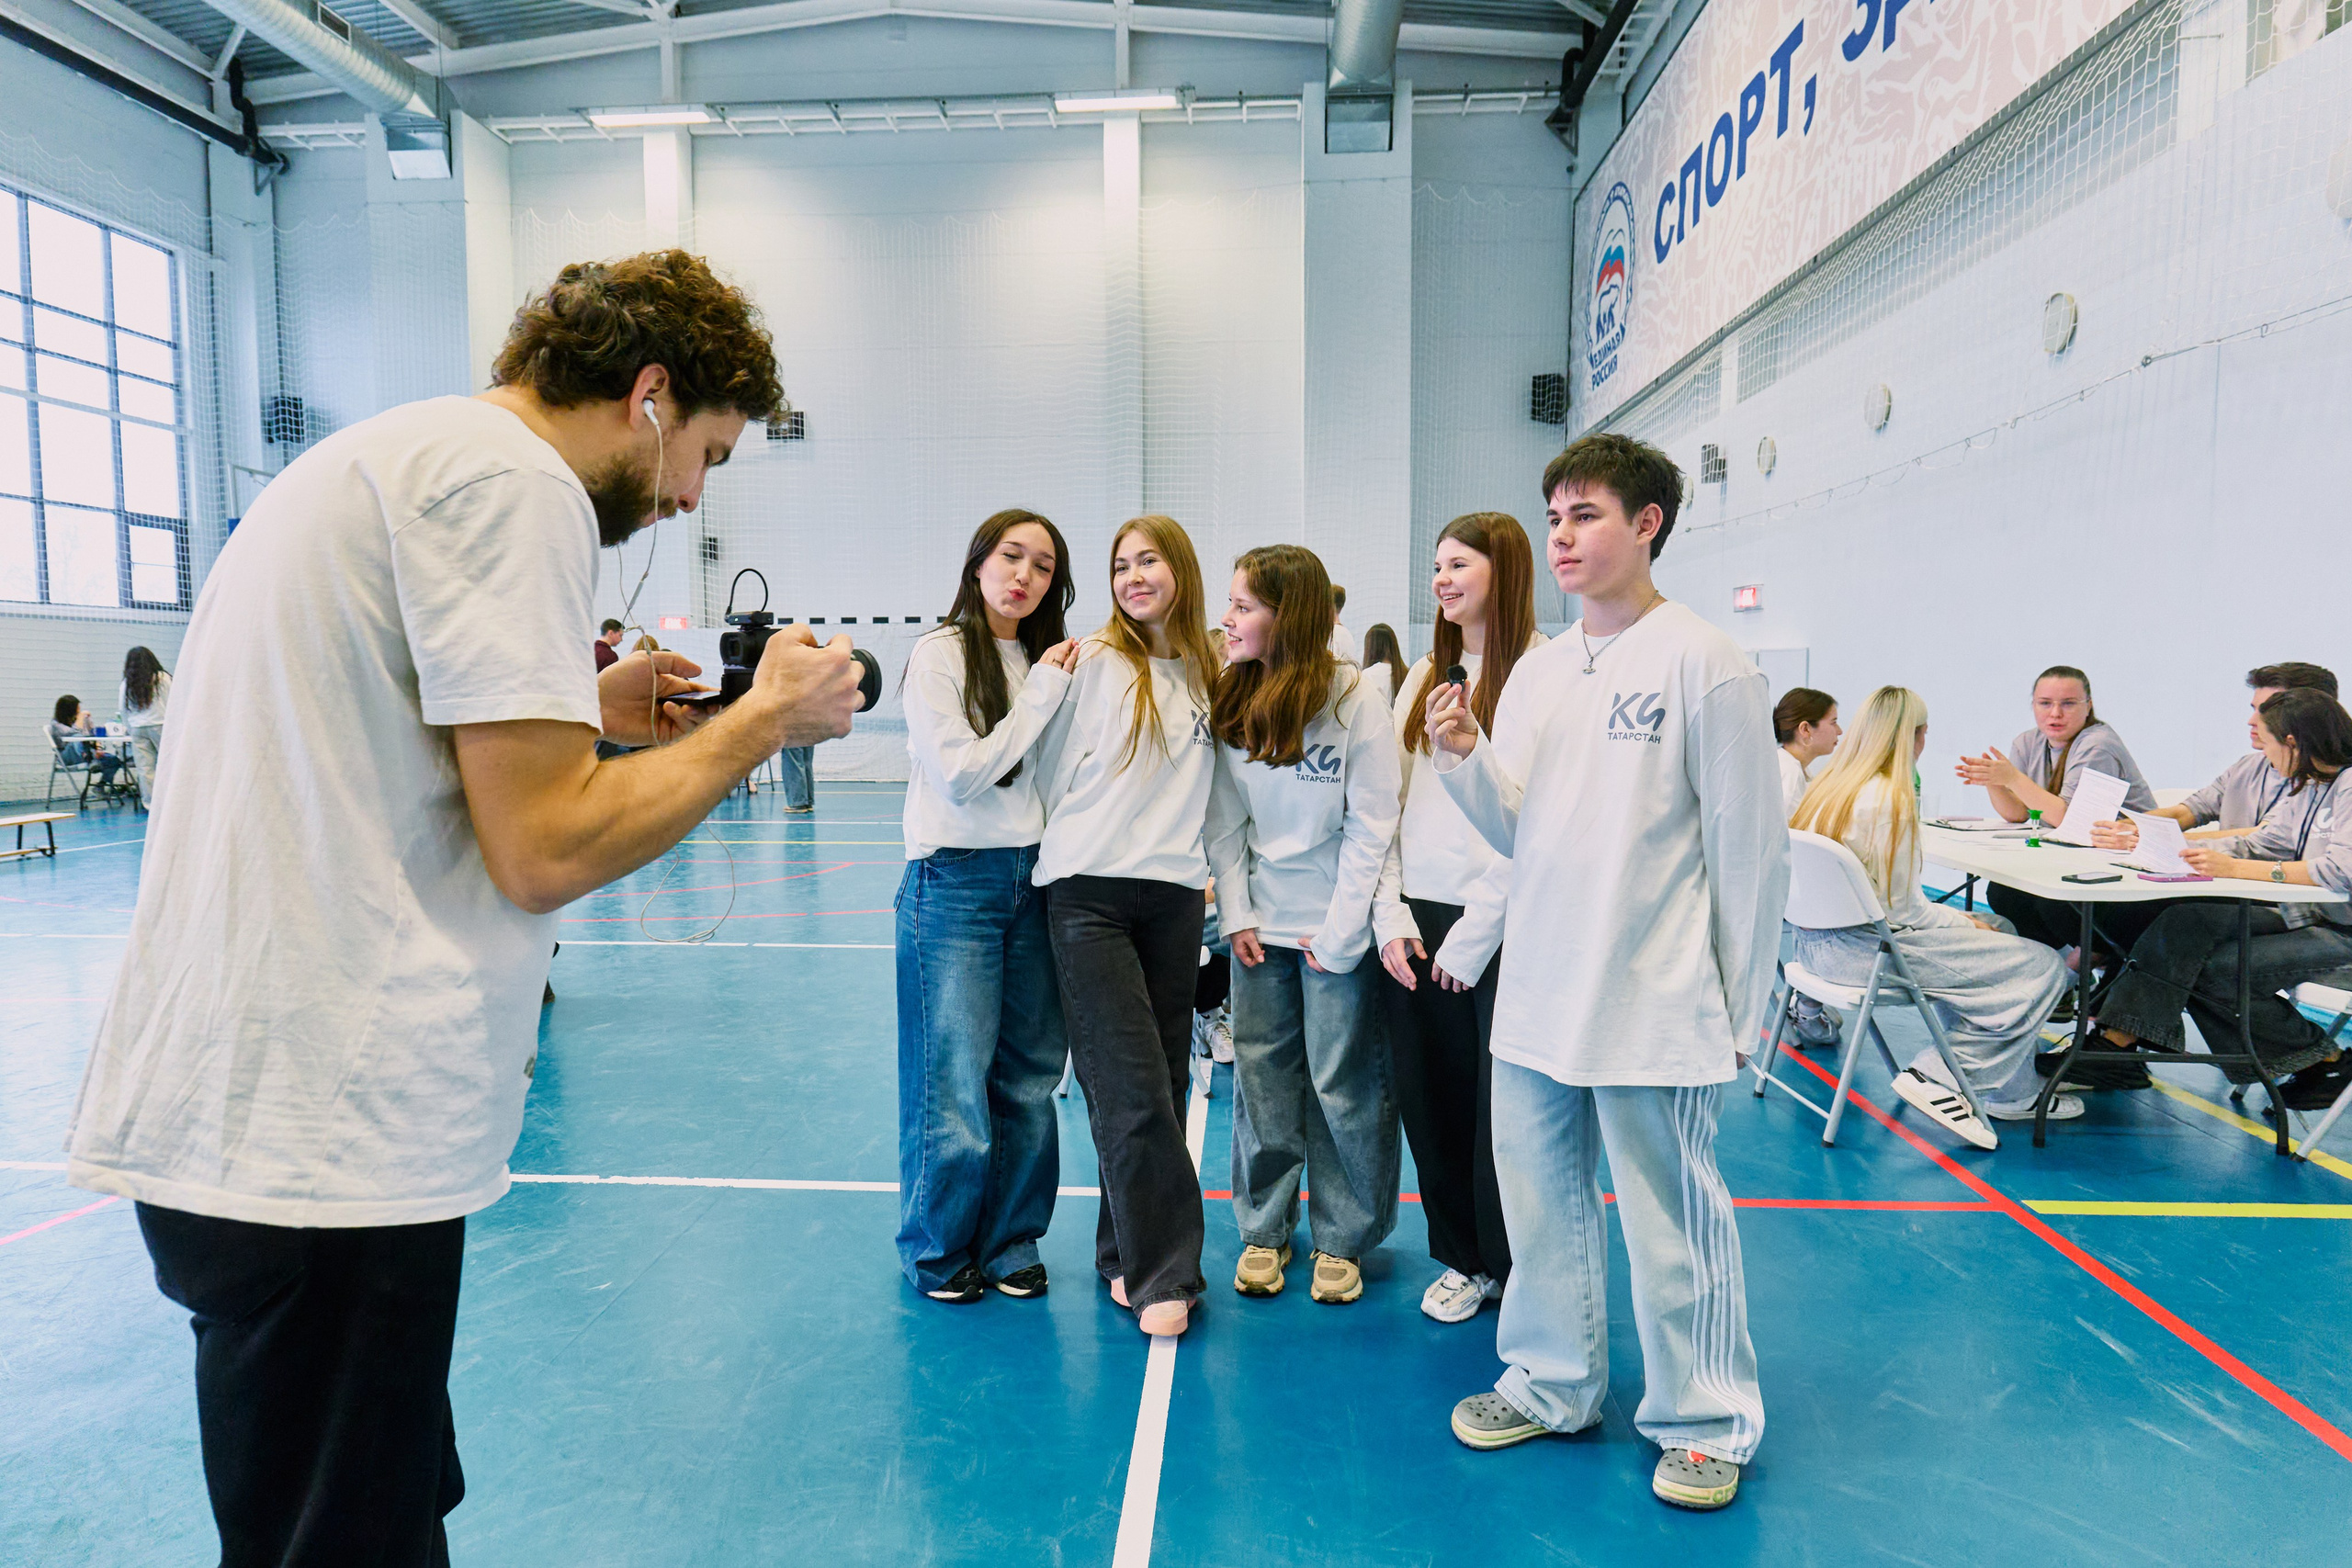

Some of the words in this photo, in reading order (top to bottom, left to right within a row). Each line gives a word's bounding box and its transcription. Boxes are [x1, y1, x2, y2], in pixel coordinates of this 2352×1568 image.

[1654, 17, 1816, 264] СПОРТ,
[1593, 332, 1621, 368] ЕДИНАЯ
[1591, 354, 1618, 391] РОССИЯ
[1608, 732, 1661, 745] ТАТАРСТАН
[1295, 773, 1341, 784] ТАТАРСТАН
